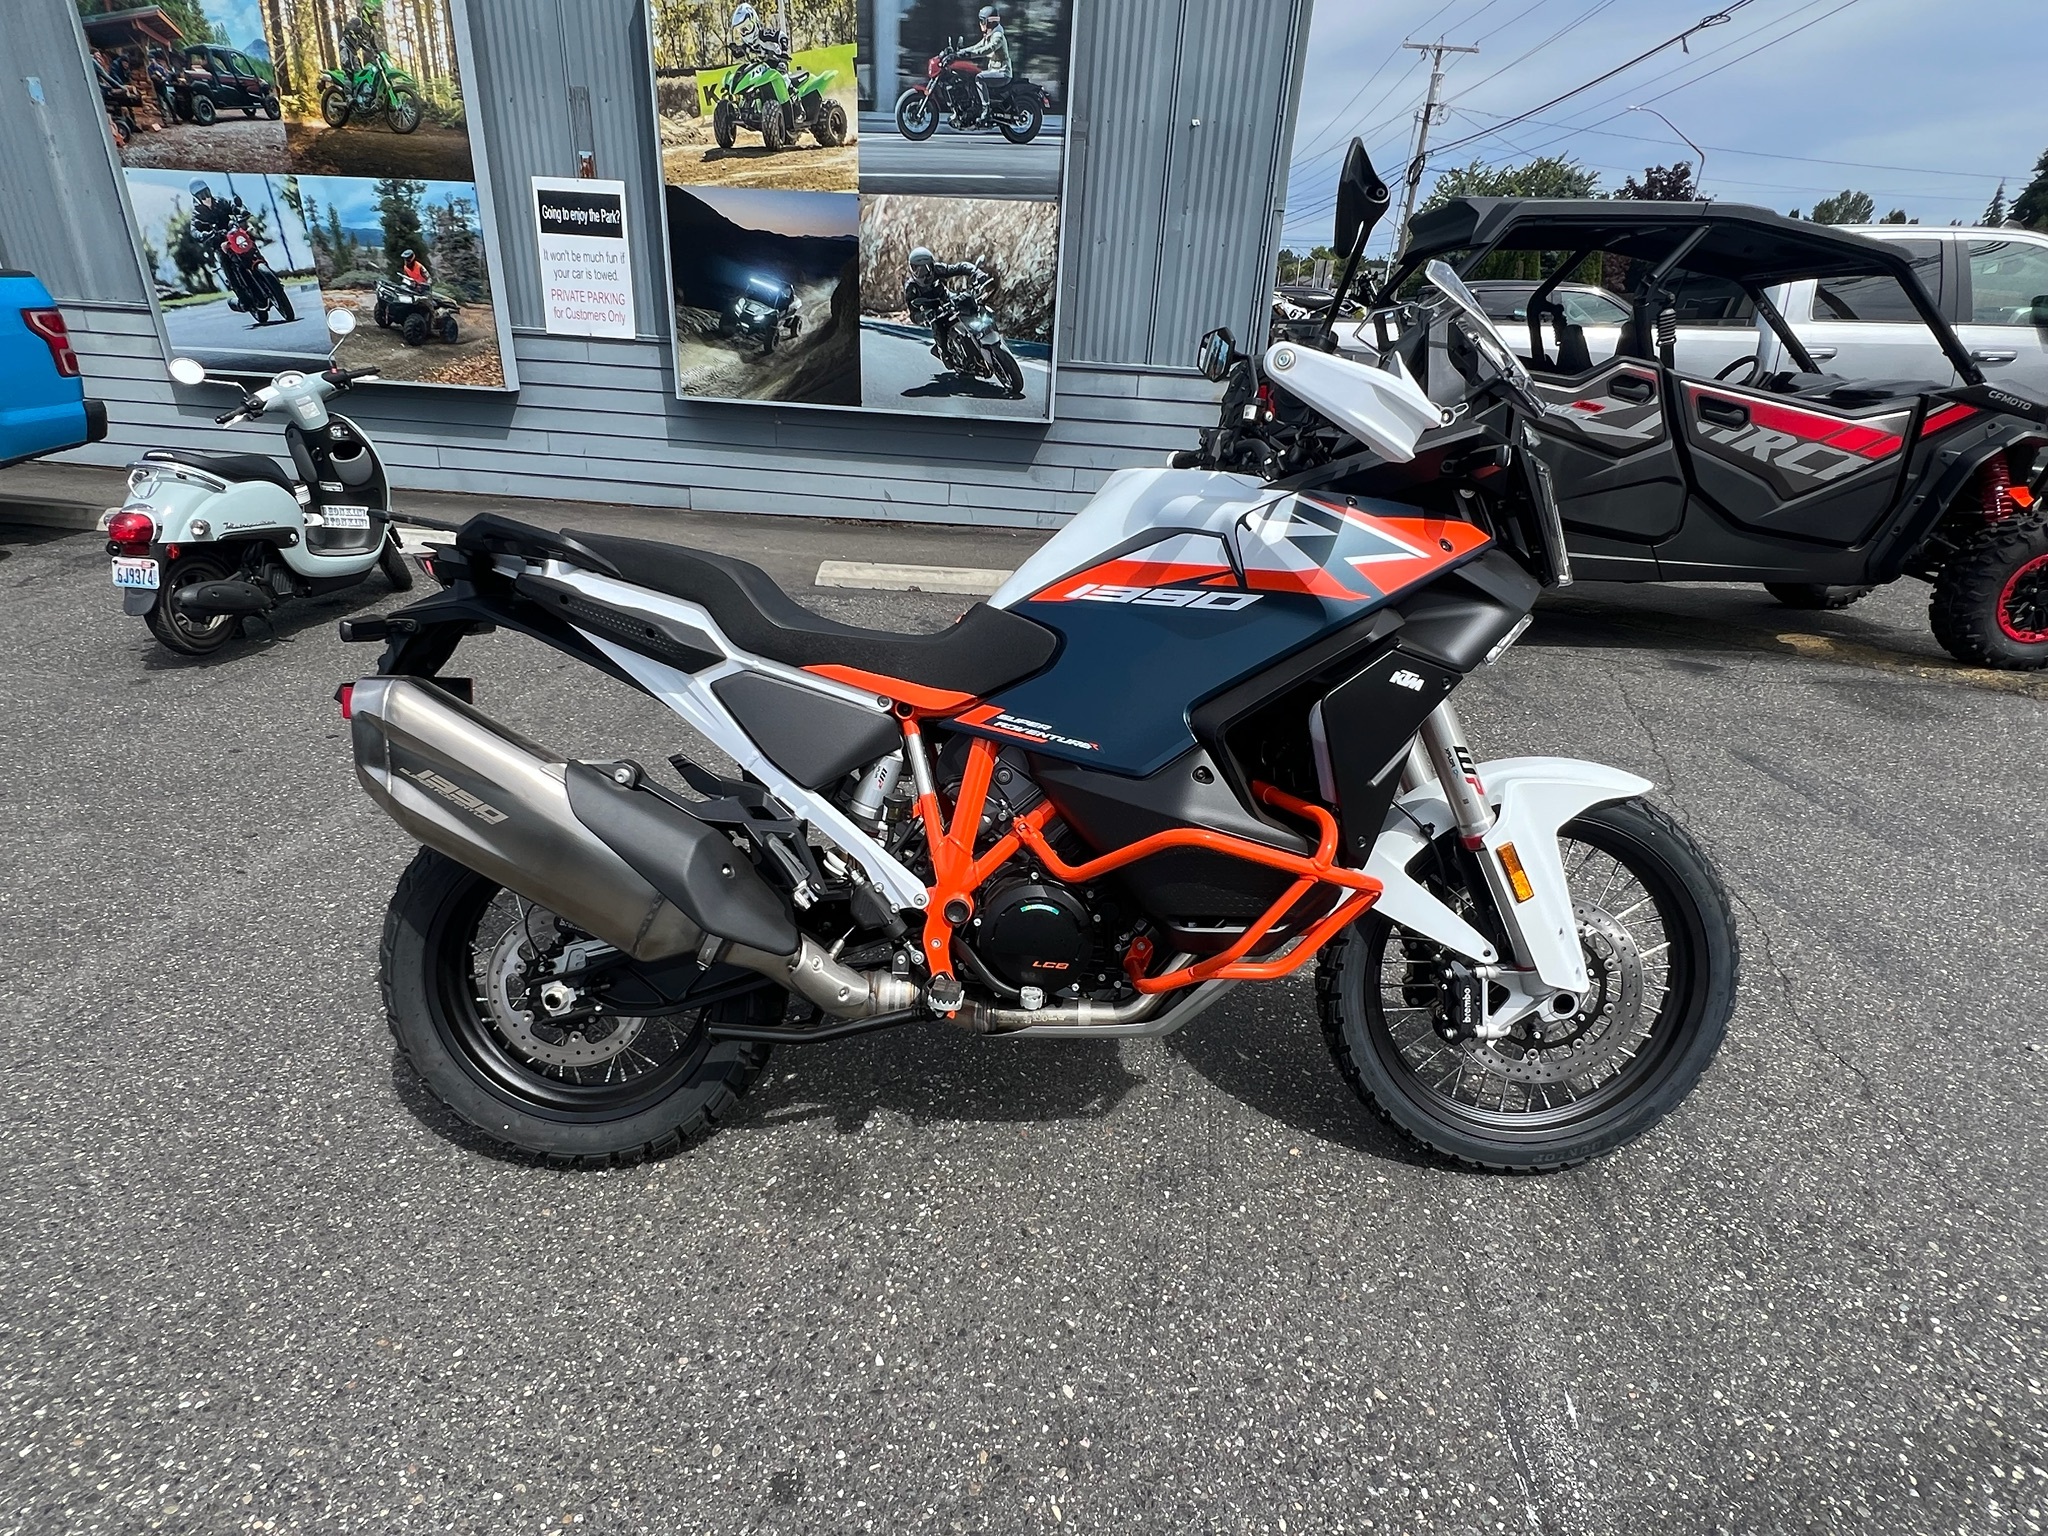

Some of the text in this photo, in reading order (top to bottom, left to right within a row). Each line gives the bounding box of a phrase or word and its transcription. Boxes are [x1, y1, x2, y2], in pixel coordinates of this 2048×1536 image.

[541, 204, 620, 226] Going to enjoy the Park?
[543, 248, 626, 265] It won't be much fun if
[553, 267, 619, 281] your car is towed.
[551, 288, 625, 306] PRIVATE PARKING
[553, 306, 625, 326] for Customers Only
[1988, 390, 2033, 411] CFMOTO
[117, 566, 153, 586] 6J9374
[1063, 583, 1265, 611] 1390
[1389, 669, 1425, 692] KTM
[996, 714, 1053, 731] SUPER
[416, 769, 509, 821] 1390
[1462, 987, 1472, 1023] brembo
